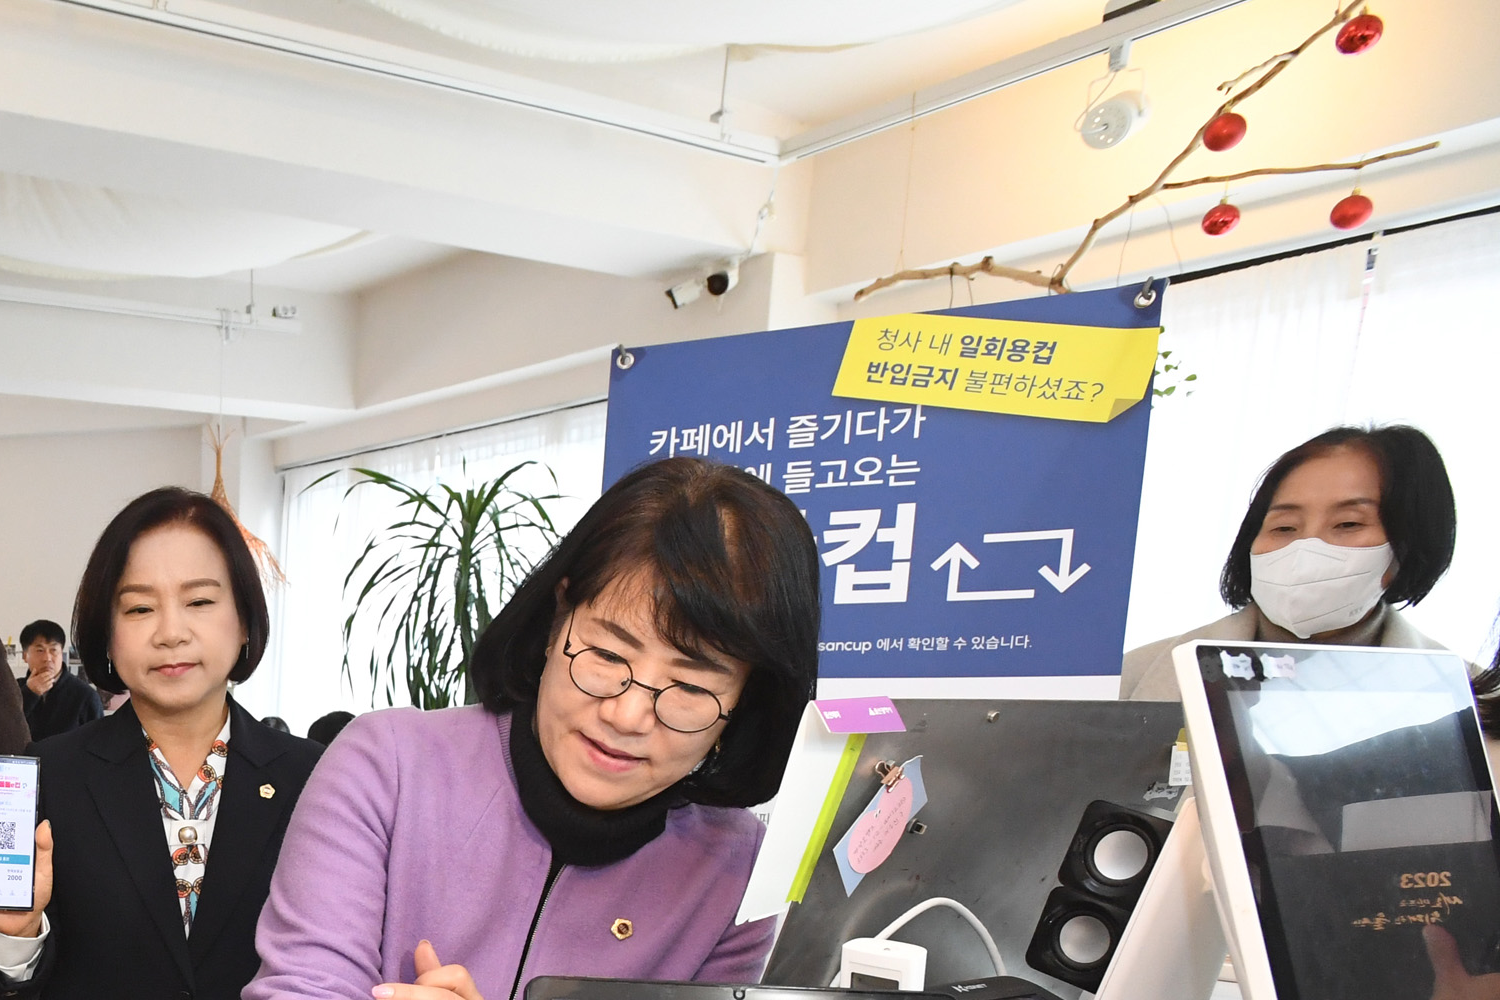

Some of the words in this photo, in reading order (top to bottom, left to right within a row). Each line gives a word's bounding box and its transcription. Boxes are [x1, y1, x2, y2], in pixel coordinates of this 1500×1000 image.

[877, 328, 922, 352] 청사
[928, 333, 953, 356] 내
[959, 335, 1057, 365] 일회용컵
[866, 361, 959, 390] 반입금지
[964, 370, 1105, 403] 불편하셨죠?
[649, 417, 776, 458] 카페에서
[786, 405, 926, 449] 즐기다가
[782, 454, 921, 494] 들고오는
[876, 638, 904, 651] 에서
[907, 637, 950, 651] 확인할
[953, 637, 967, 650] 수
[971, 635, 1033, 650] 있습니다.
